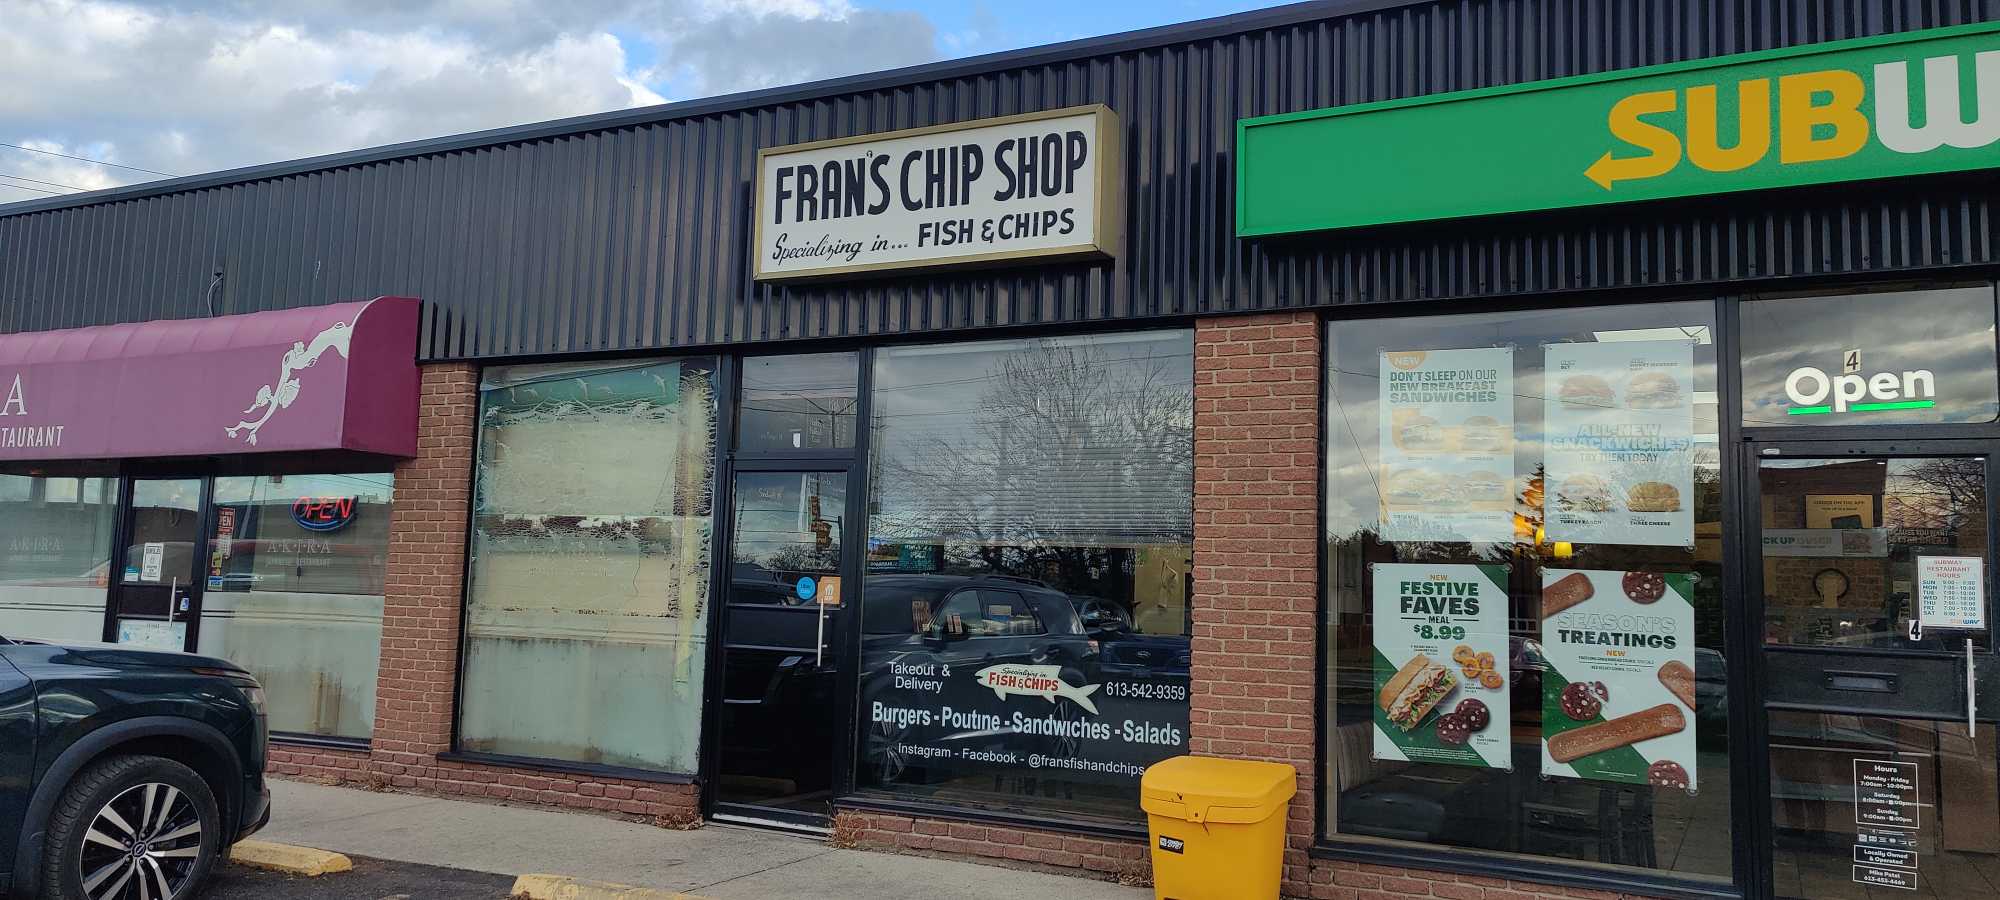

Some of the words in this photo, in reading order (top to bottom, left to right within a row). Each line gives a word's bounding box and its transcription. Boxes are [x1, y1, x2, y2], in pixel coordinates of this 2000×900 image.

[1583, 50, 2000, 192] SUBW
[774, 152, 891, 224] FRAN'S
[900, 143, 984, 212] CHIP
[994, 130, 1088, 202] SHOP
[772, 232, 862, 265] Specializing
[917, 218, 974, 248] FISH
[998, 207, 1076, 240] CHIPS
[1846, 351, 1858, 371] 4
[1390, 371, 1423, 381] DON'T
[1425, 371, 1456, 381] SLEEP
[1458, 370, 1473, 380] ON
[1475, 369, 1497, 380] OUR
[1390, 382, 1420, 391] NEW
[1421, 381, 1497, 391] BREAKFAST
[1785, 367, 1935, 412] Open
[1390, 391, 1497, 403] SANDWICHES
[293, 496, 354, 519] OPEN
[1400, 582, 1479, 596] FESTIVE
[1400, 596, 1480, 615] FAVES
[1428, 616, 1451, 624] MEAL
[1558, 612, 1677, 634] SEASON'S
[1911, 620, 1920, 639] 4
[1413, 624, 1466, 640] $8.99
[1558, 629, 1677, 649] TREATINGS
[1605, 649, 1627, 657] NEW
[889, 662, 934, 677] Takeout
[941, 664, 951, 677] &
[894, 676, 943, 694] Delivery
[988, 671, 1016, 688] FISH
[1024, 678, 1060, 692] CHIPS
[1105, 681, 1186, 701] 613-542-9359
[872, 700, 931, 729] Burgers
[941, 706, 1000, 731] Poutine
[1012, 711, 1110, 740] Sandwiches
[1122, 719, 1181, 746] Salads
[898, 742, 951, 760] Instagram
[962, 748, 1017, 765] Facebook
[1028, 753, 1145, 777] @fransfishandchips
